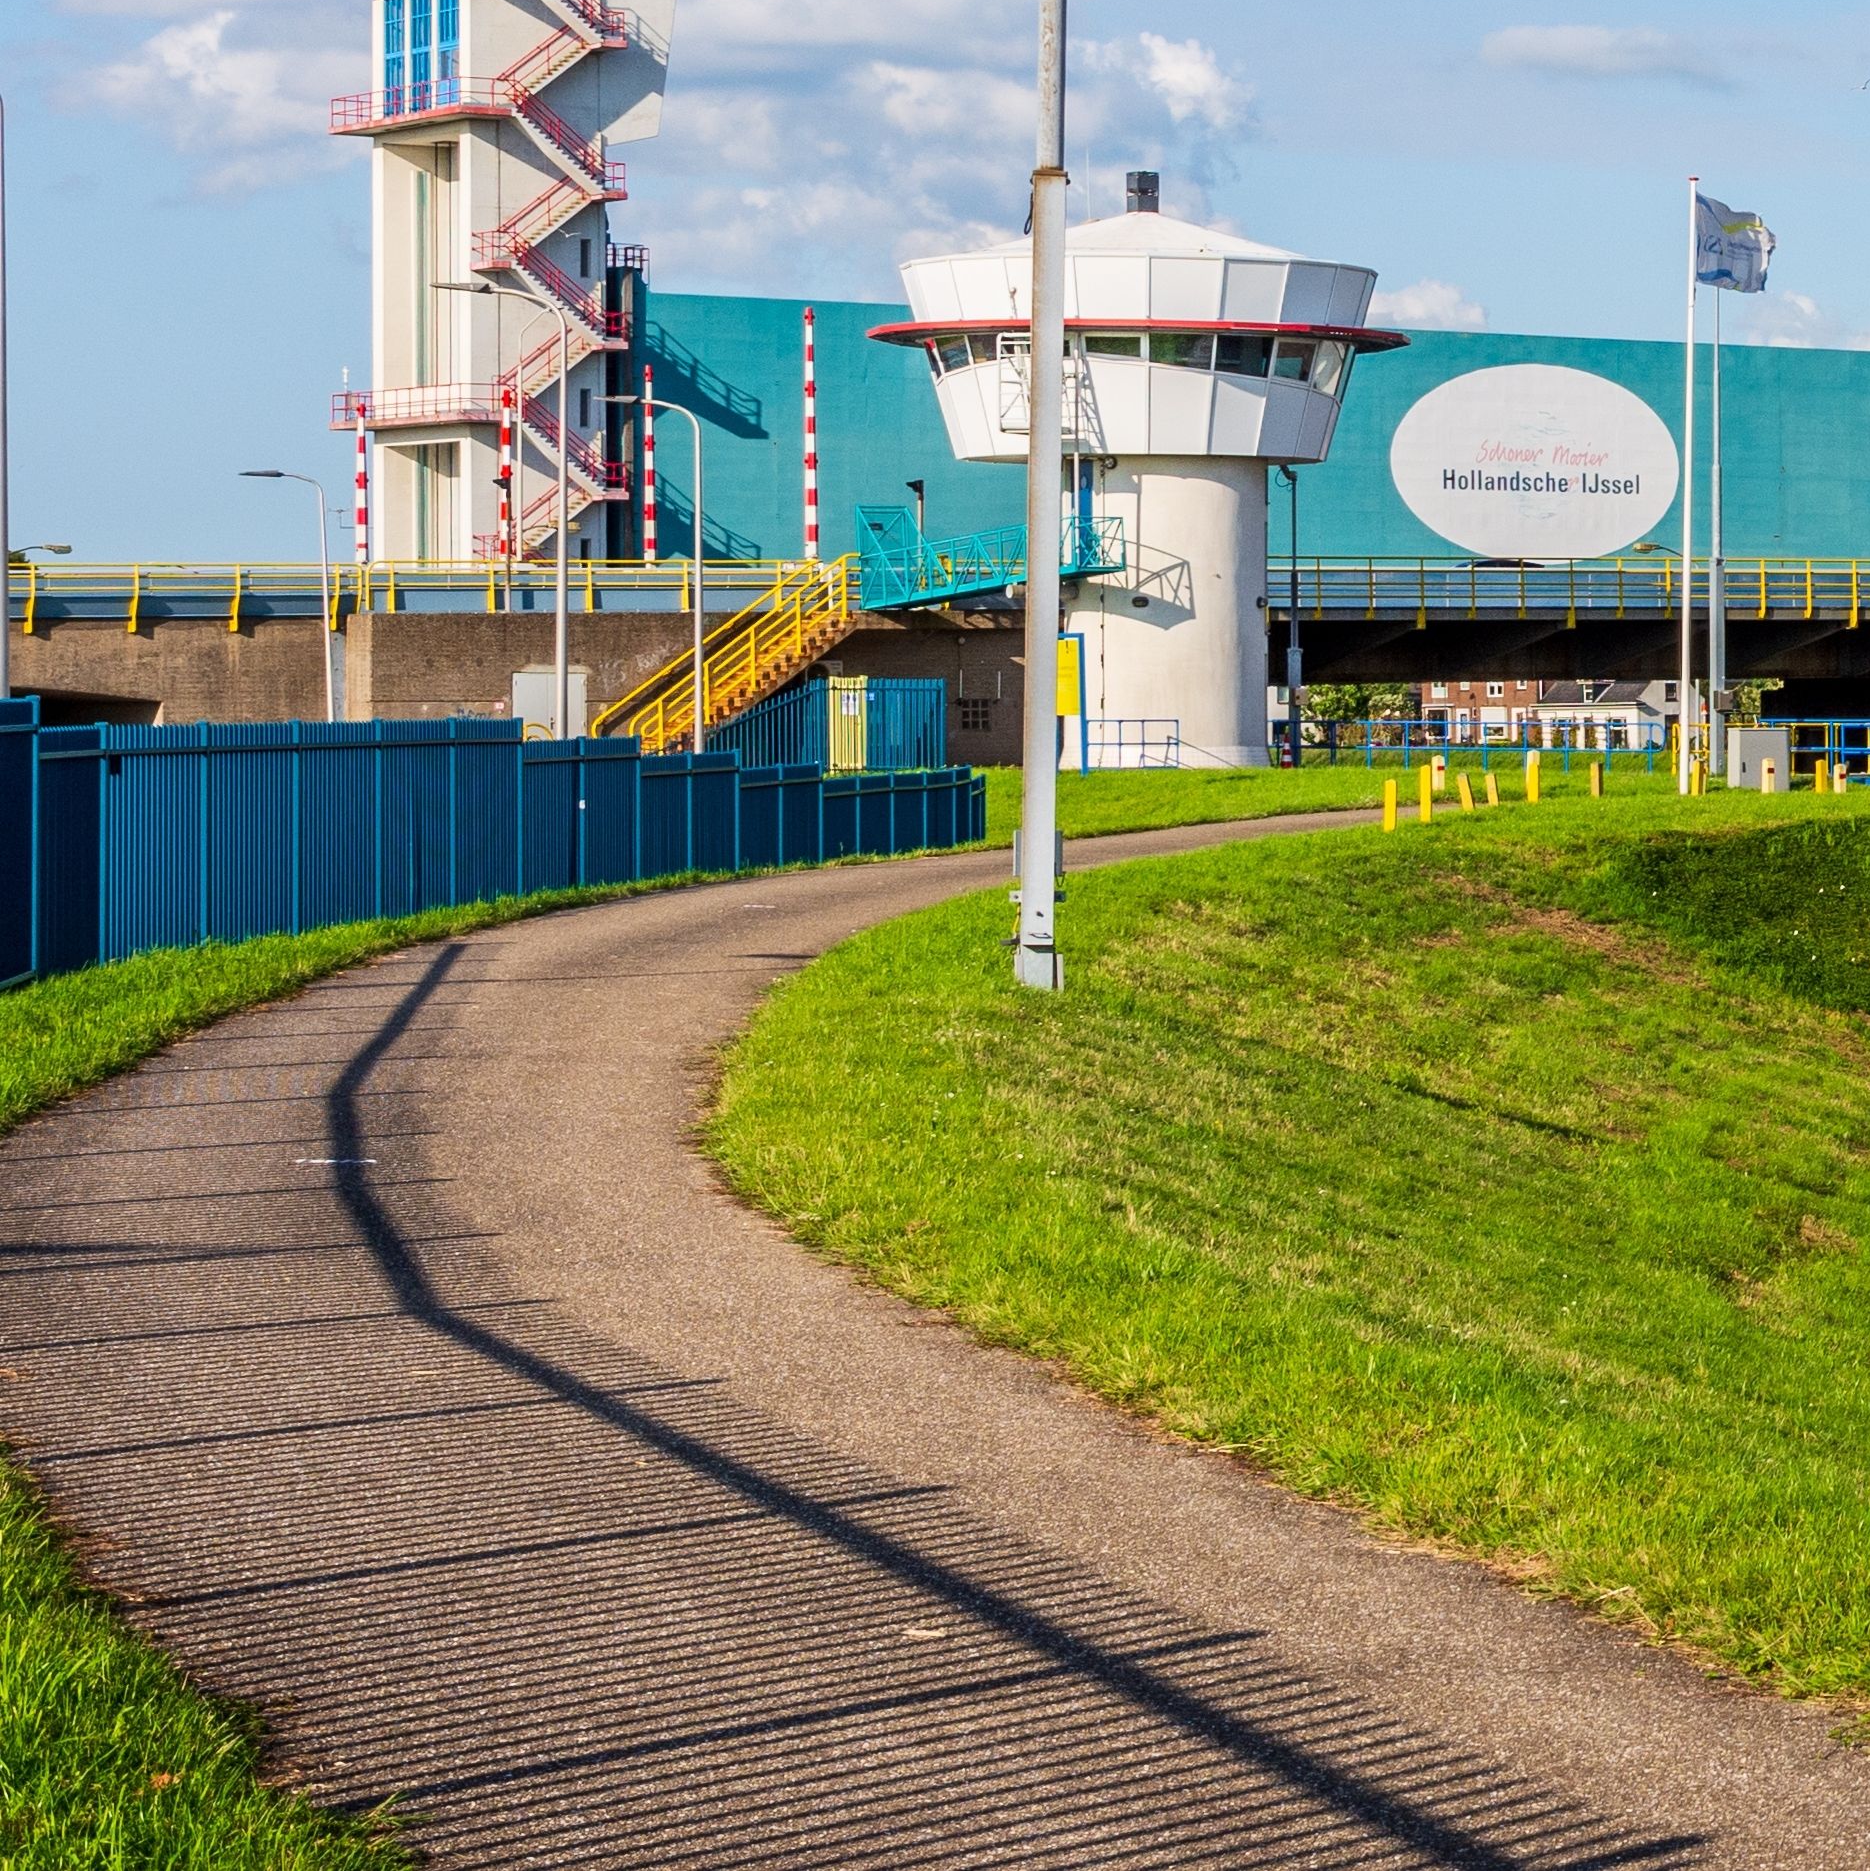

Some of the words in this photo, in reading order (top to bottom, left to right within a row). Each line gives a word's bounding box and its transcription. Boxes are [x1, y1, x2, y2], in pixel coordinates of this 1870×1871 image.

[1476, 438, 1543, 464] Schoner
[1552, 441, 1609, 467] Mooier
[1582, 472, 1640, 495] IJssel
